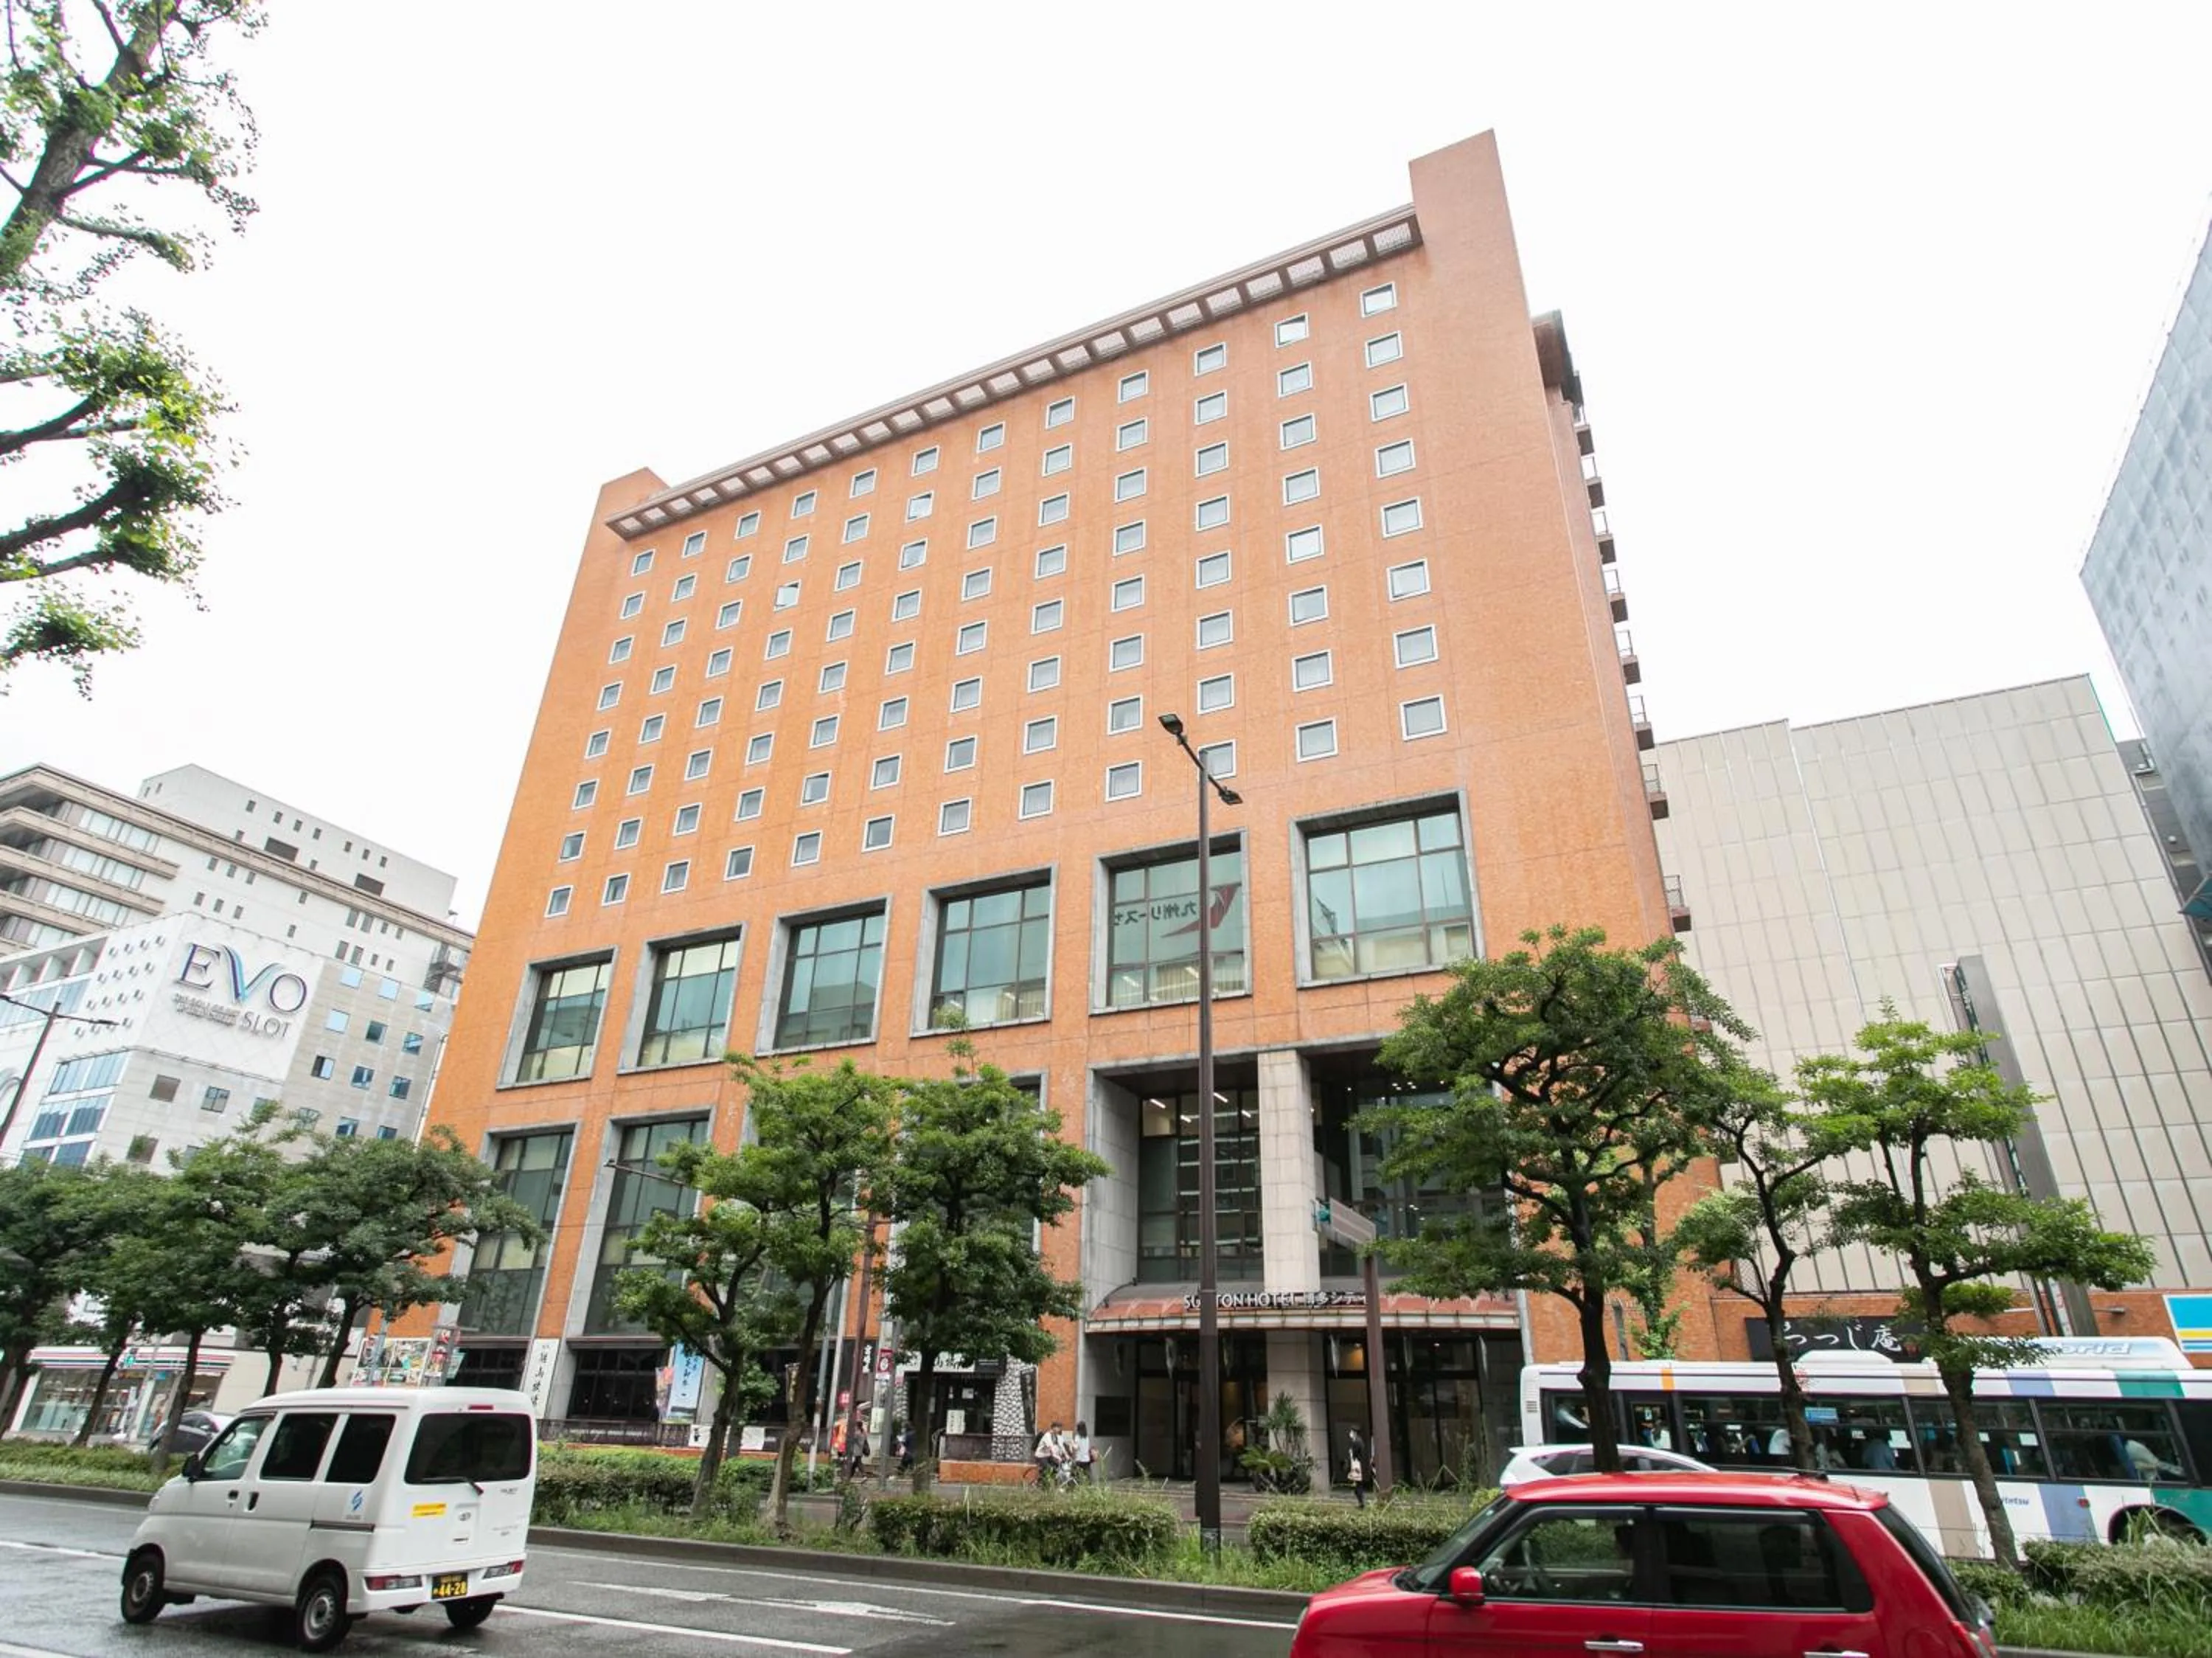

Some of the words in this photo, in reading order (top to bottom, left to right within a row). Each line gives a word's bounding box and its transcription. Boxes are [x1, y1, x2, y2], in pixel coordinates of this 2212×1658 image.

[173, 944, 307, 1013] EVO
[240, 1012, 293, 1038] SLOT
[1183, 1294, 1244, 1308] SUTON
[1247, 1292, 1295, 1306] HOTEL
[2051, 1342, 2131, 1354] orld
